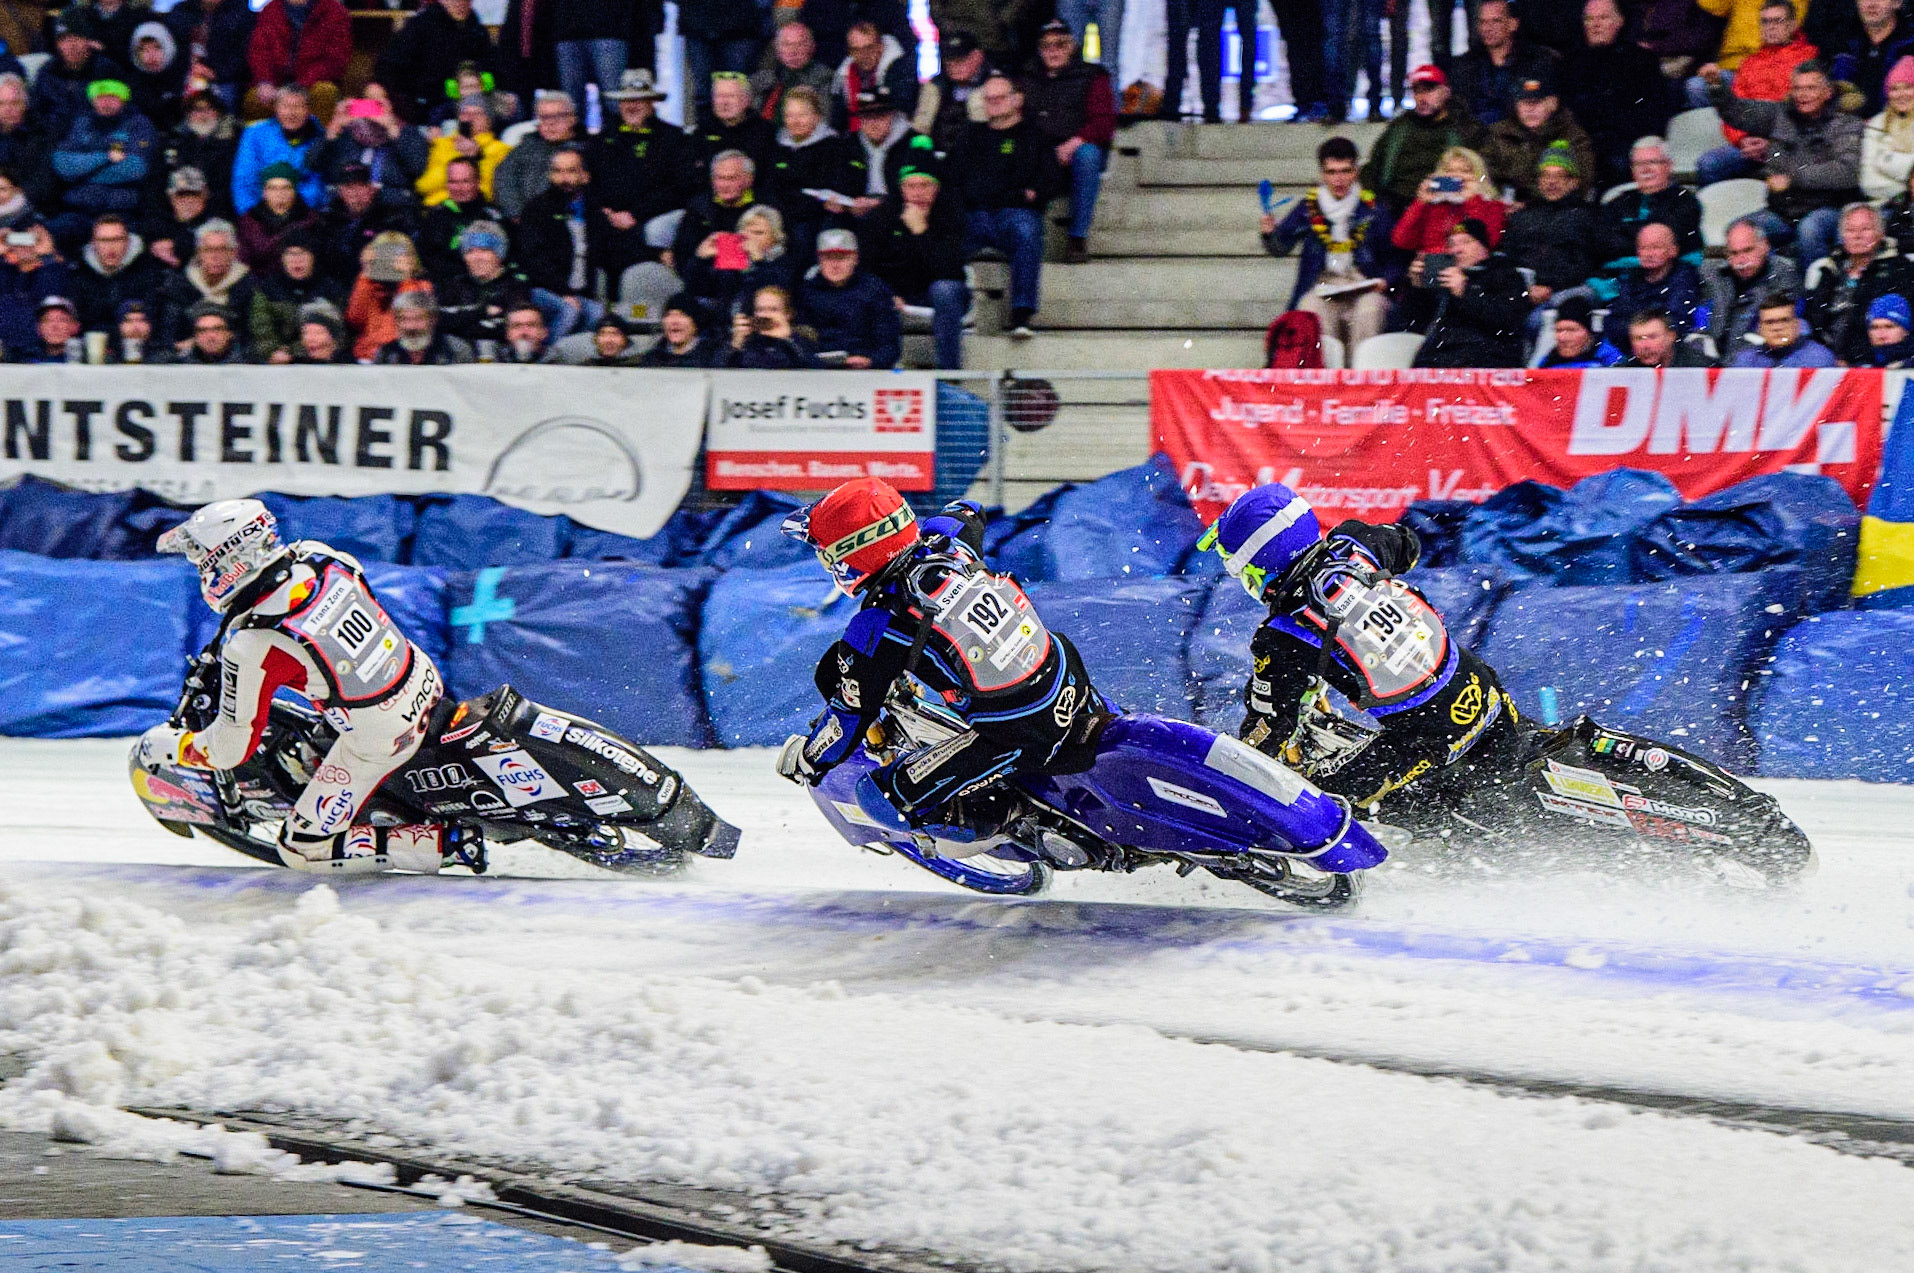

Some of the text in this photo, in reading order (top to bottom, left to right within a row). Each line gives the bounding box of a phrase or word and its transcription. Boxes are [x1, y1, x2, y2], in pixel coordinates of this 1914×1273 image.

[719, 395, 866, 424] Josef Fuchs
[1567, 368, 1851, 456] DMV
[4, 399, 454, 471] NTSTEINER
[1257, 466, 1419, 514] Mtorsport
[328, 586, 345, 605] Zorn
[967, 592, 1009, 635] 192
[337, 609, 373, 650] 100
[1363, 601, 1403, 642] 199
[401, 668, 435, 722] WACO
[536, 720, 563, 733] FUCHS
[404, 763, 469, 793] 100
[497, 768, 545, 786] FUCHS
[320, 788, 353, 835] FUCHS
[1650, 801, 1712, 825] MOTO
